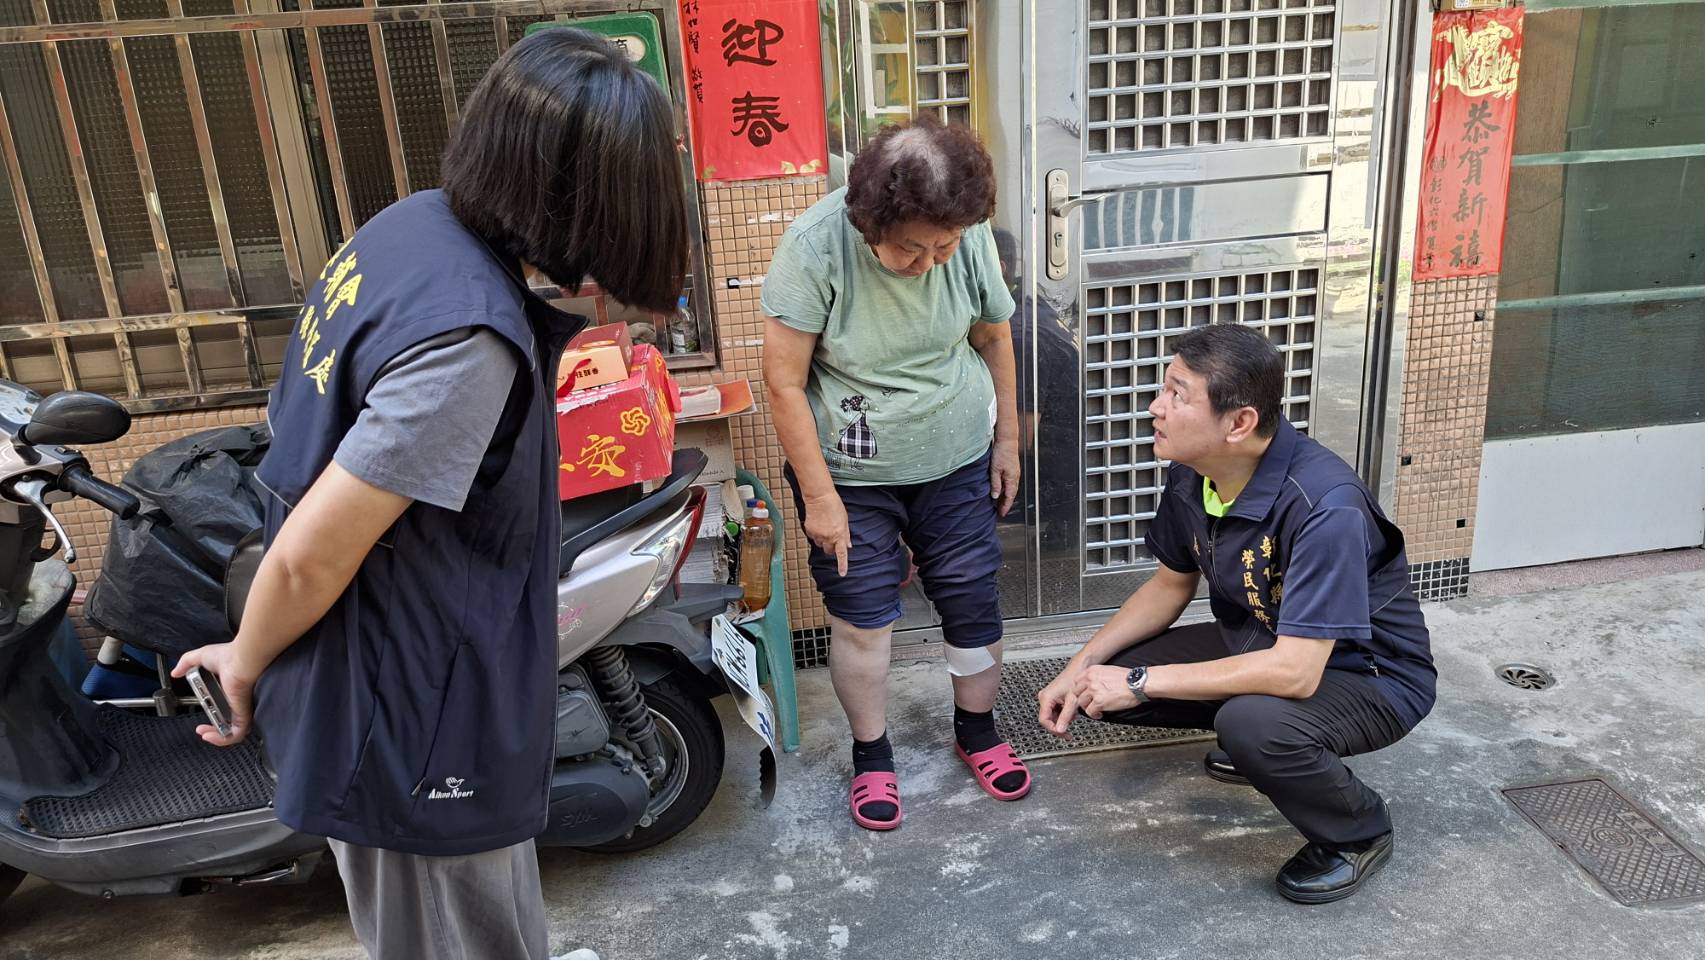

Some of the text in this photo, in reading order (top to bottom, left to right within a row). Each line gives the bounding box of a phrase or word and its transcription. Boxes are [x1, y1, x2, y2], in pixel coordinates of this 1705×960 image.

[721, 18, 790, 148] 迎春
[1449, 100, 1501, 268] 恭賀新禧
